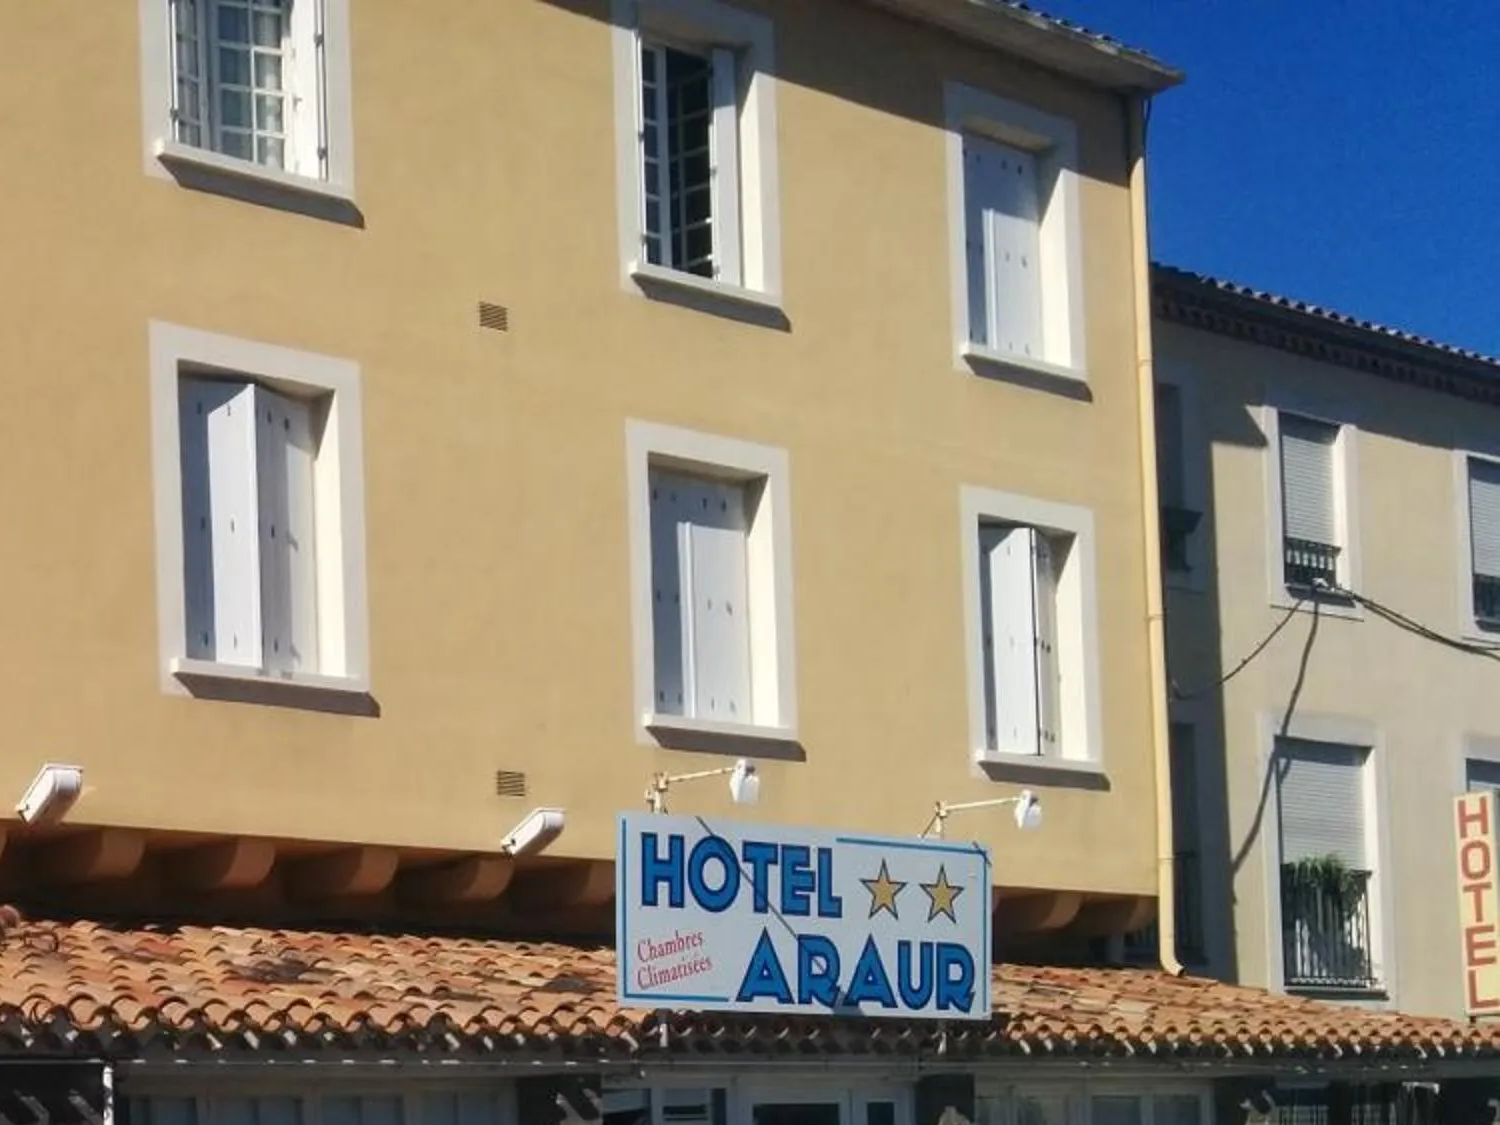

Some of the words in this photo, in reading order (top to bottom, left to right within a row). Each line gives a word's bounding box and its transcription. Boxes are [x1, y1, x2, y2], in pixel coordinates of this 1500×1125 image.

[640, 831, 843, 919] HOTEL
[1457, 796, 1500, 1010] HOTEL
[637, 929, 704, 962] Chambres
[735, 926, 976, 1014] ARAUR
